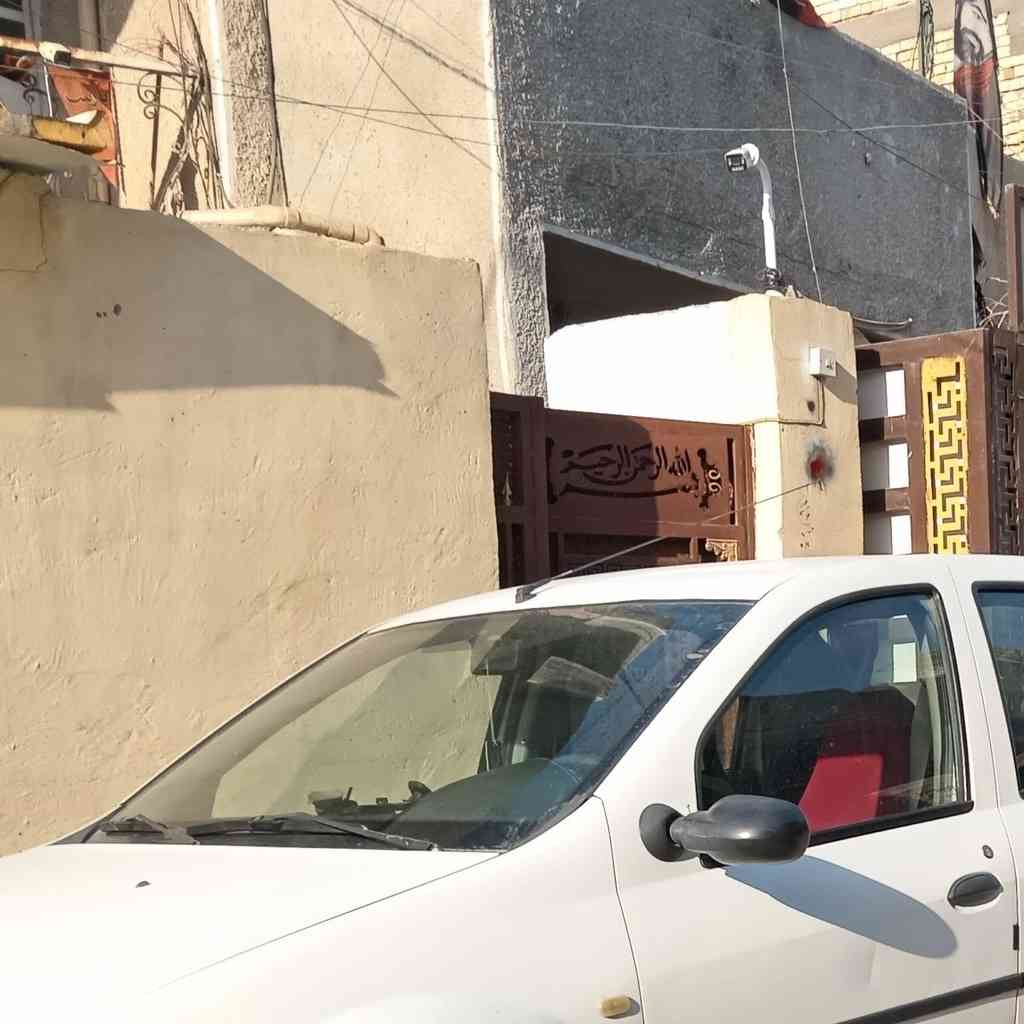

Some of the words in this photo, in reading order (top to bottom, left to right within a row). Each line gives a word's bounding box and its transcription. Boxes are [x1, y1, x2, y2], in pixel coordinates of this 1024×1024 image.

[560, 444, 631, 479] الرحيم
[669, 446, 692, 476] الله
[559, 472, 699, 498] بسم
